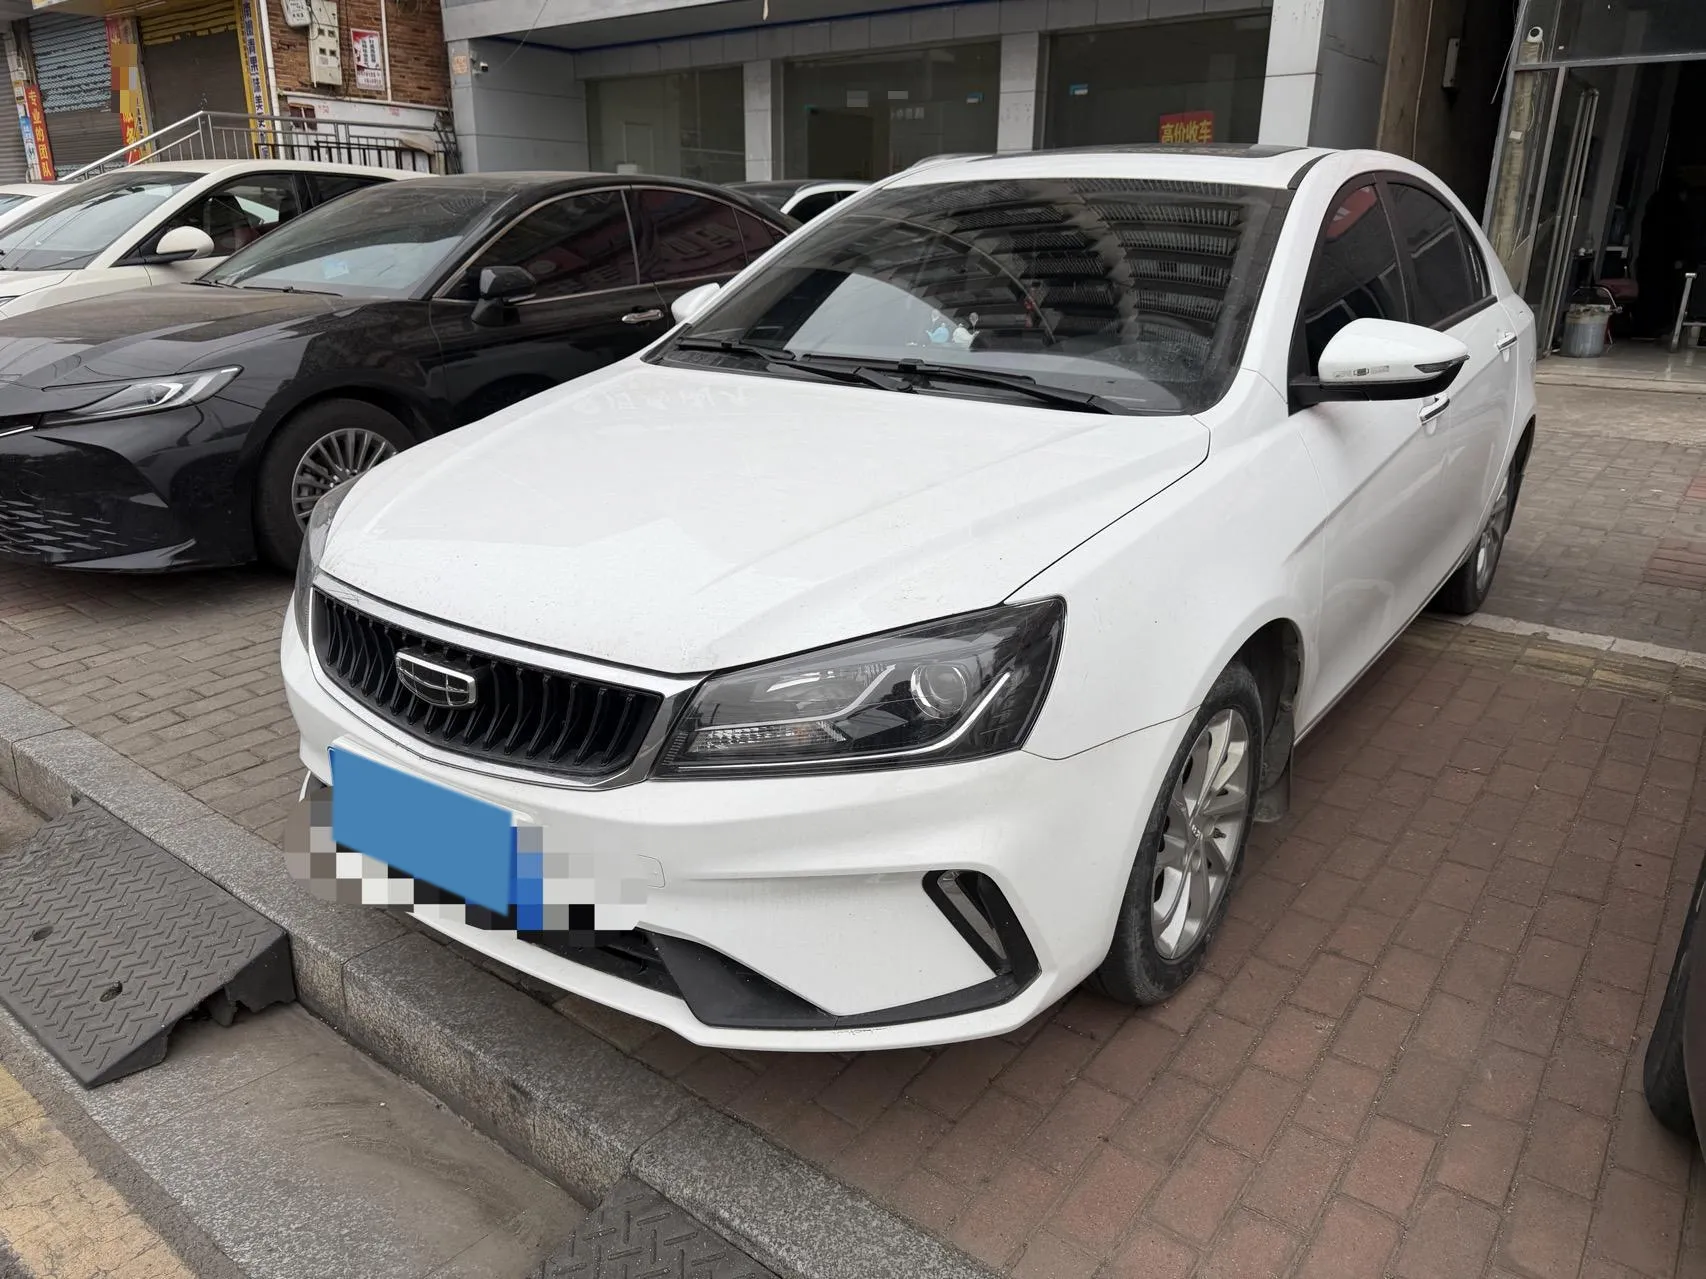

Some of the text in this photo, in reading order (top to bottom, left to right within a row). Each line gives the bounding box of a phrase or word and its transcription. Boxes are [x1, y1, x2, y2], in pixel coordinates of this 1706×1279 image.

[28, 90, 52, 178] 专业的团队
[1161, 119, 1213, 144] 高价收车
